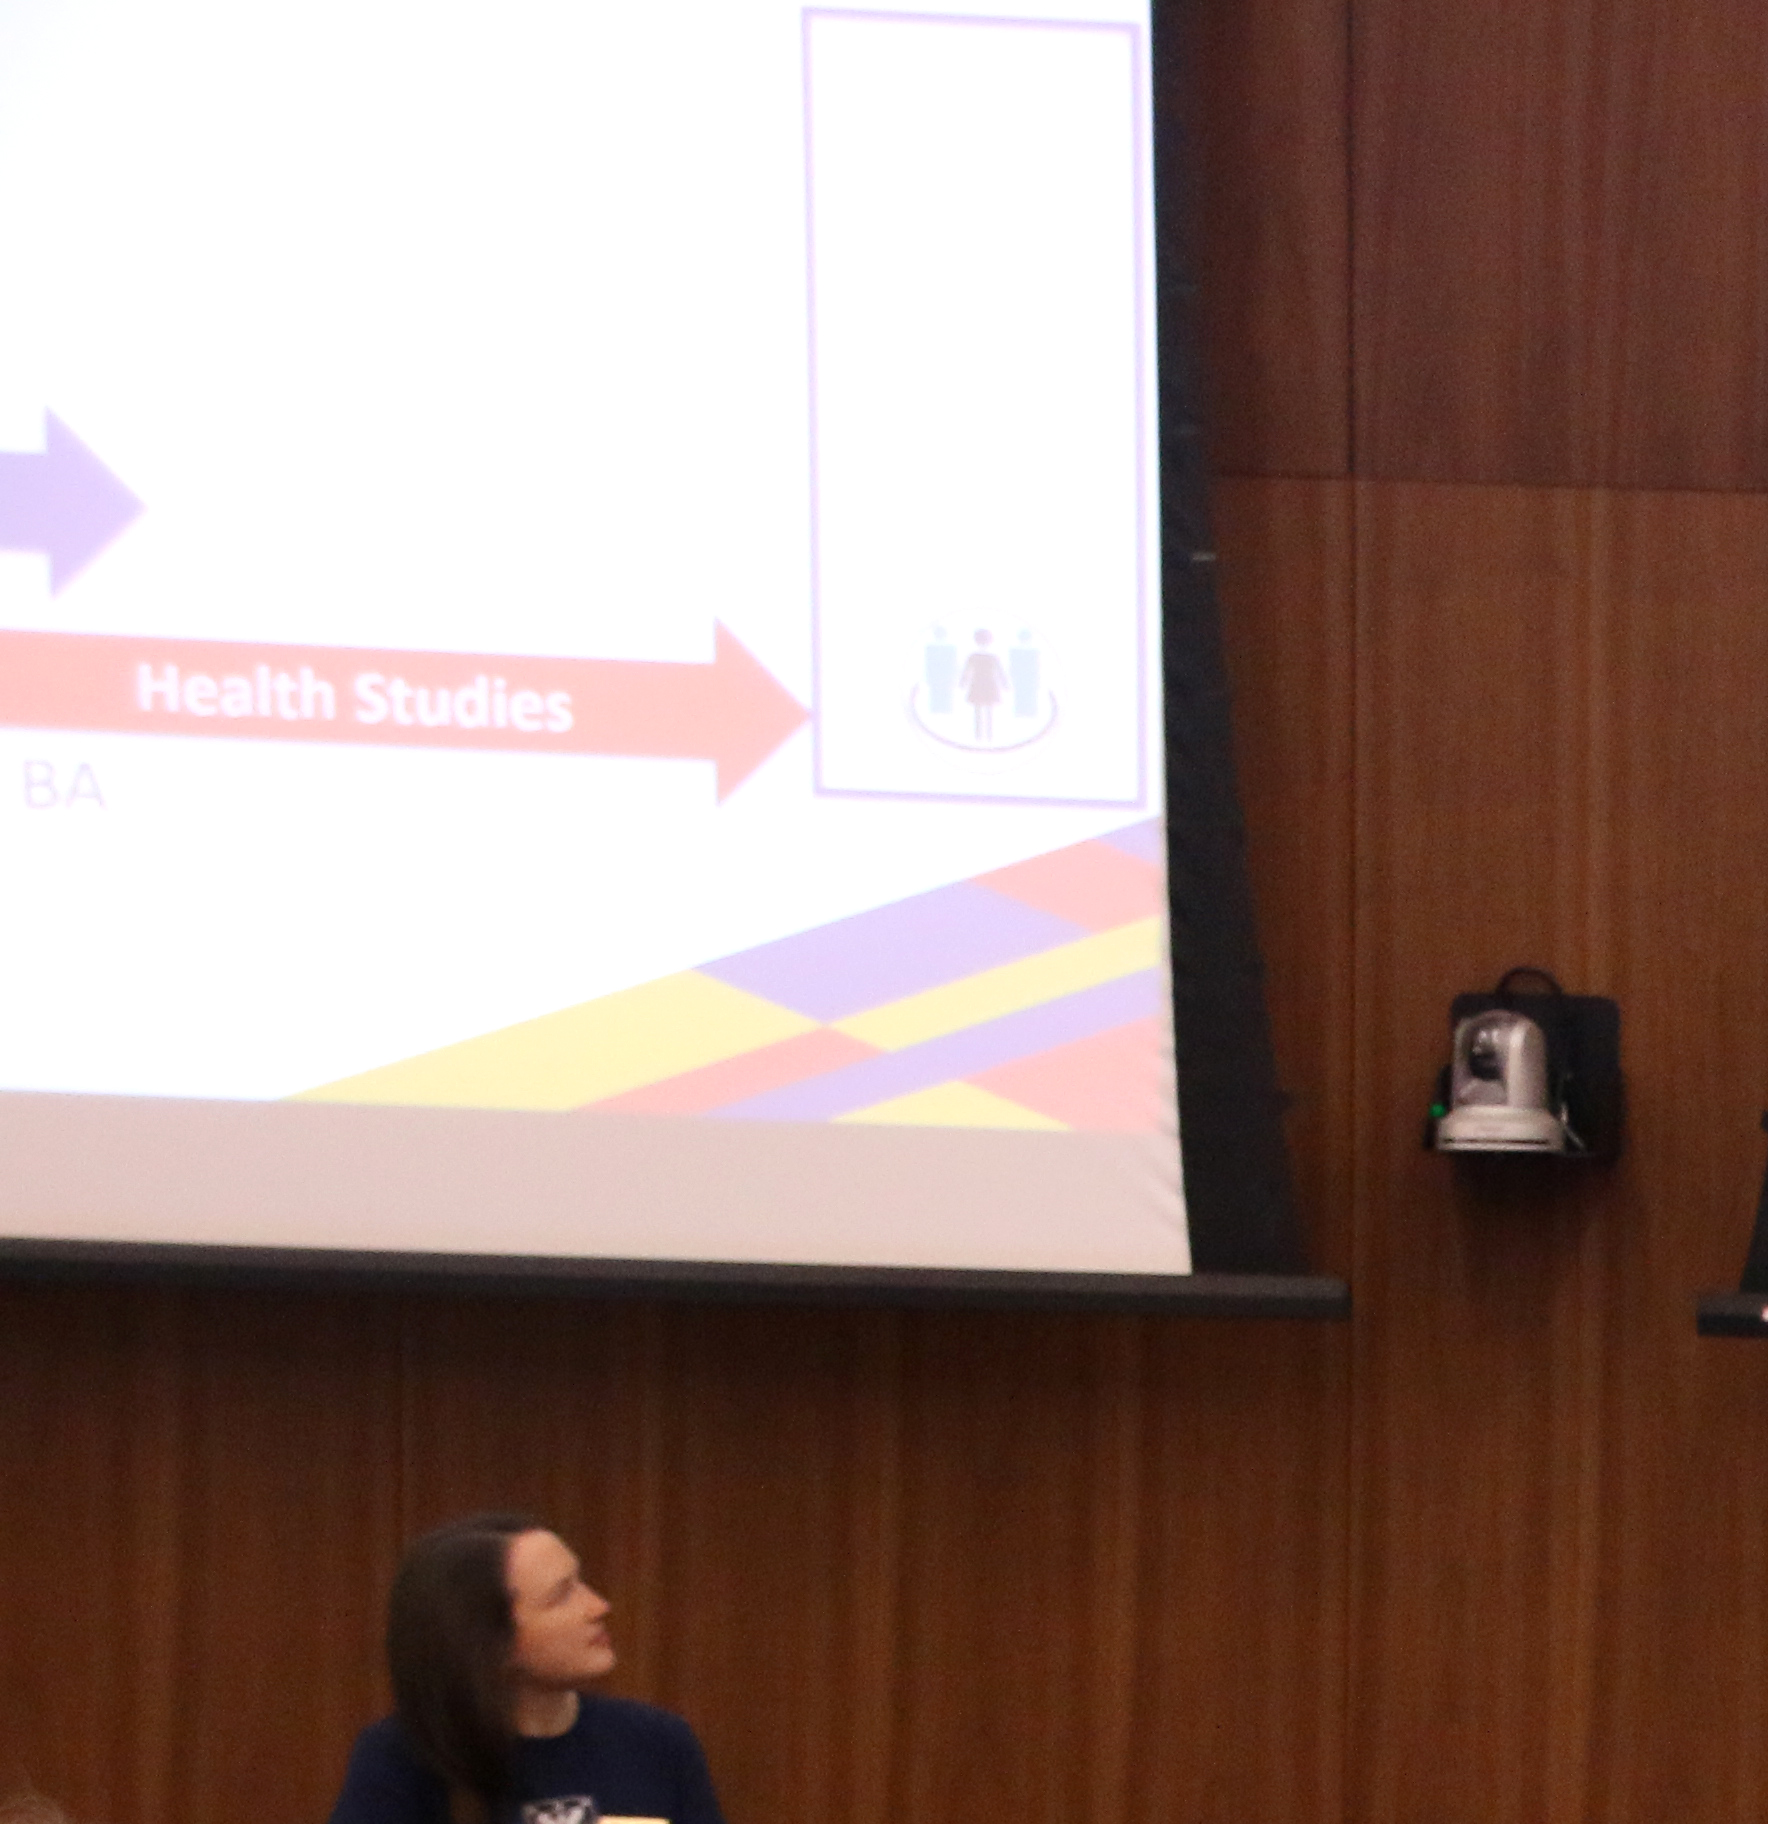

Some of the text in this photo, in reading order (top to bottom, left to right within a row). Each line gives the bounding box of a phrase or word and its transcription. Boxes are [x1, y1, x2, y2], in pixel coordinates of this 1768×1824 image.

[136, 662, 575, 734] Health Studies
[21, 758, 108, 812] BA
